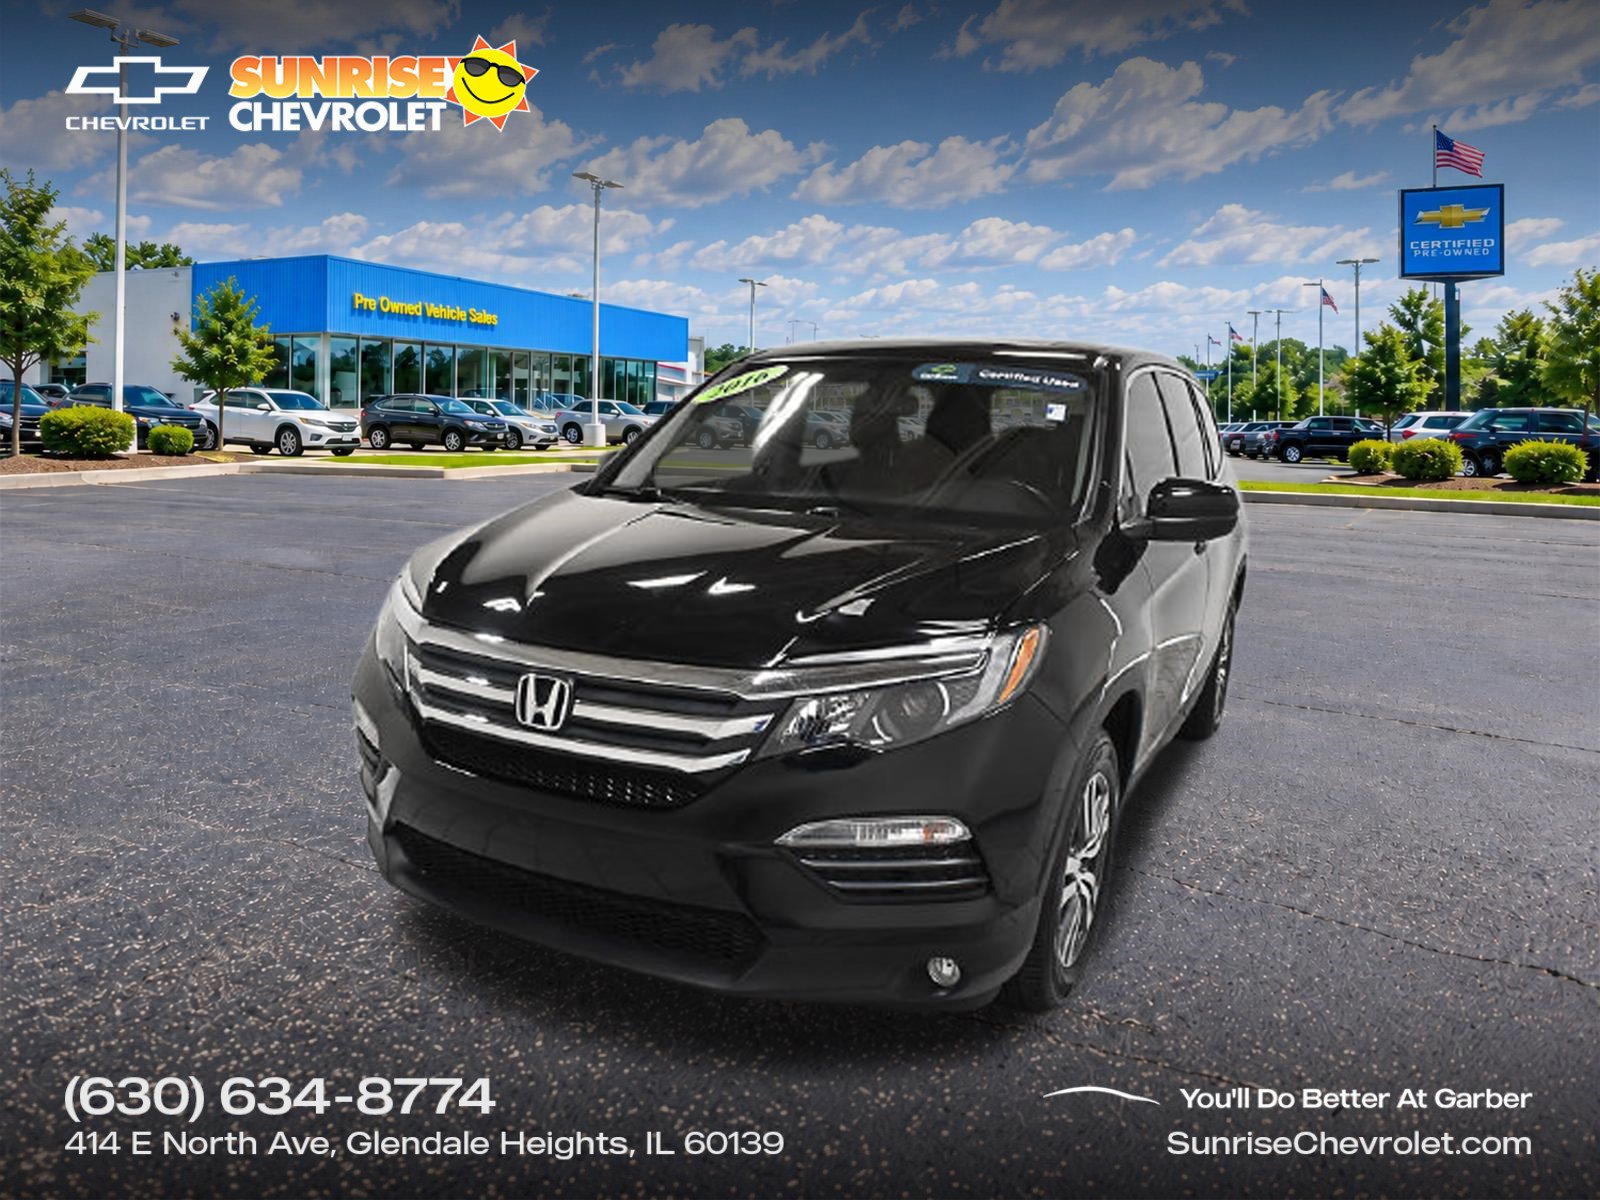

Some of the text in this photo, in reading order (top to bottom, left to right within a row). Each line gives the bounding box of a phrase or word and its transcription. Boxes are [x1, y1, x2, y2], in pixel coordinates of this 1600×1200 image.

[1410, 238, 1495, 250] CERTIFIED
[1413, 247, 1490, 257] PRE-OWNED
[354, 293, 498, 325] Pre Owned Vehicle Sales
